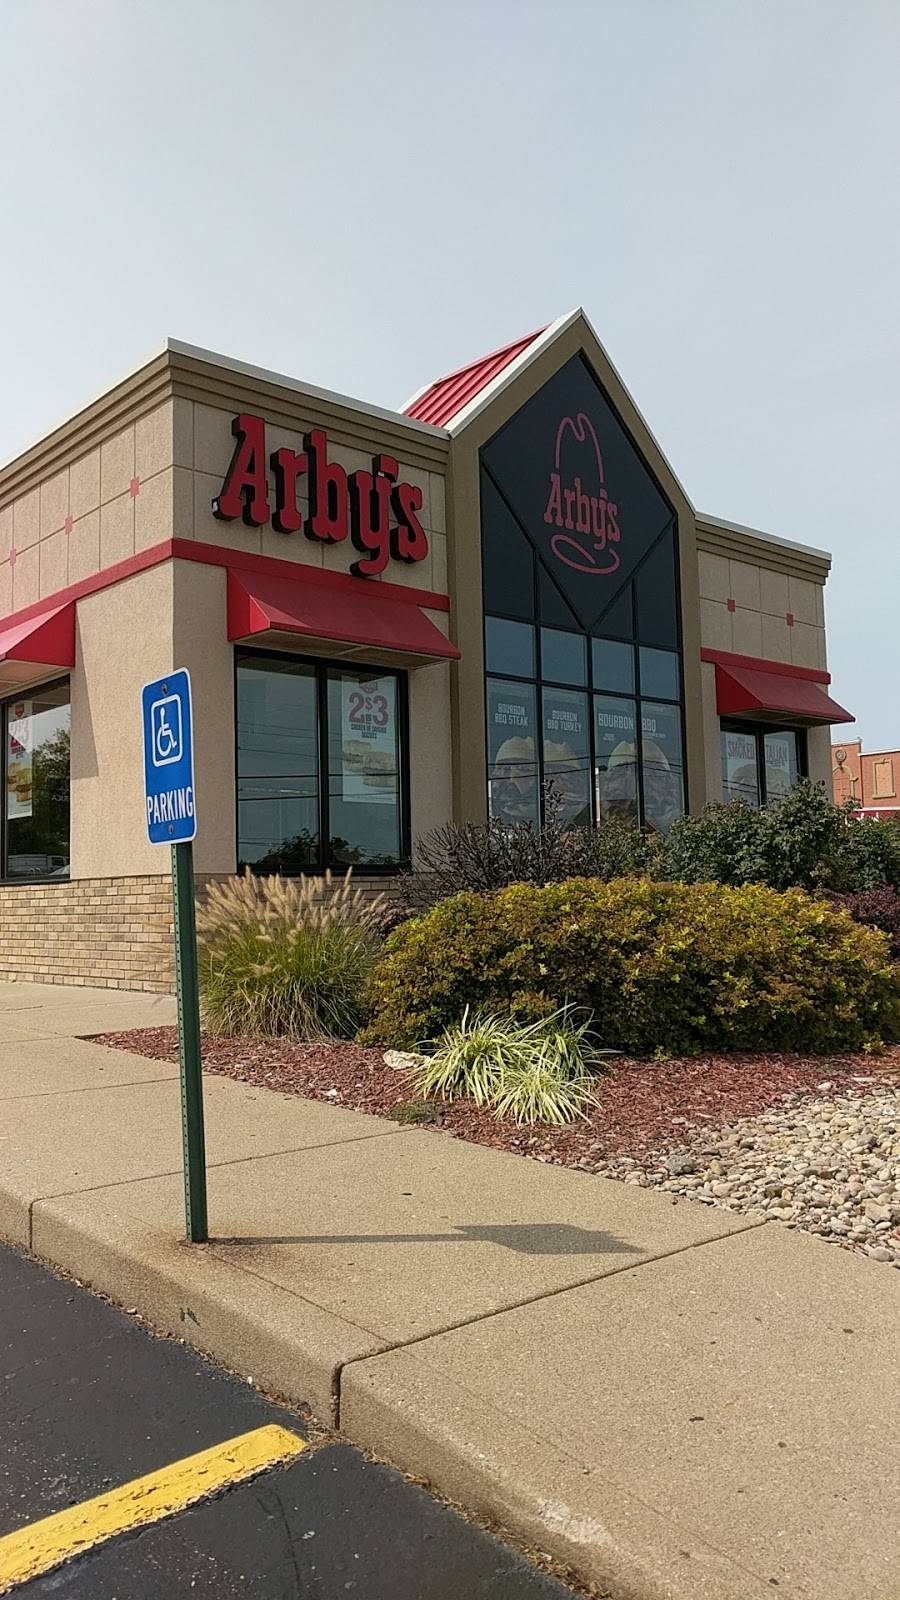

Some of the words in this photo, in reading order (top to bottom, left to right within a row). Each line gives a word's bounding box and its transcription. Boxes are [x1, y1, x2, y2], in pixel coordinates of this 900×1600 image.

[212, 413, 429, 577] Arby's
[543, 473, 621, 550] Arby's
[498, 703, 525, 715] BOURBON
[551, 710, 578, 723] BOURBON
[494, 713, 508, 725] BBQ
[508, 715, 529, 727] STEAK
[560, 722, 582, 733] TURKEY
[598, 713, 634, 731] BOURBON
[641, 718, 657, 732] BBQ
[727, 741, 755, 760] SMOKED
[147, 786, 193, 825] PARKING
